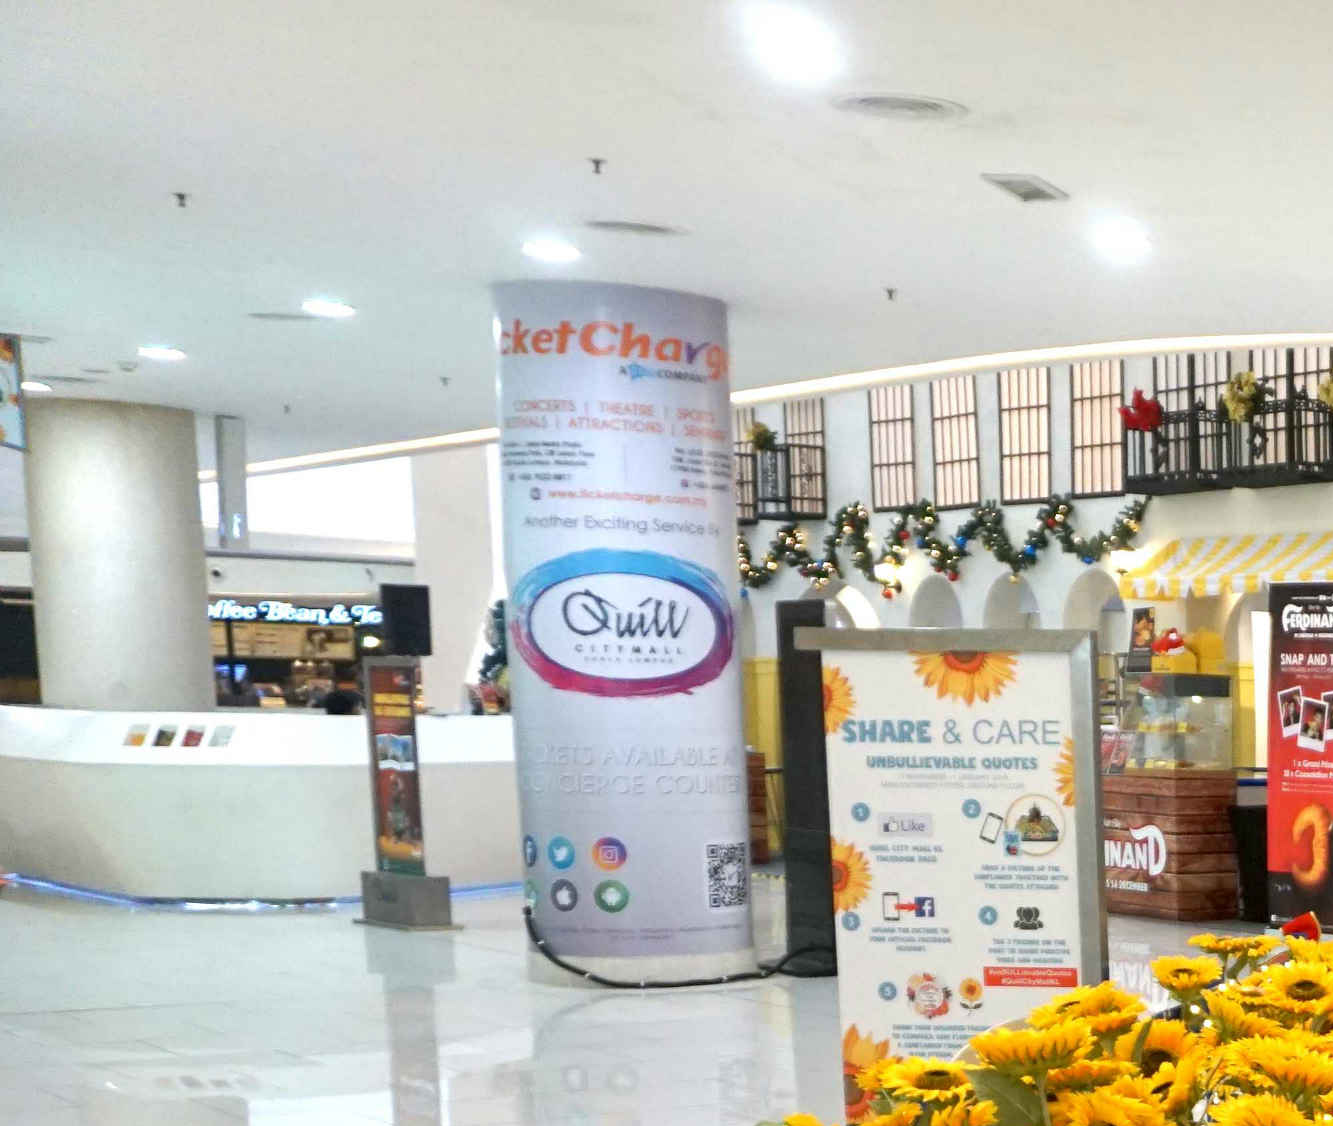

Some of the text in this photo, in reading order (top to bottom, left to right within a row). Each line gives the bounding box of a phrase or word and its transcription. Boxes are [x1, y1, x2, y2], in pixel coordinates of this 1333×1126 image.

[600, 402, 655, 417] THEATRE
[568, 418, 664, 434] ATTRACTIONS
[523, 515, 579, 530] Another
[584, 515, 648, 535] Exciting
[653, 518, 705, 536] Service
[259, 601, 329, 625] Bean
[352, 605, 383, 624] Te
[563, 589, 690, 639] Quill
[1280, 653, 1304, 665] SNAP
[1307, 654, 1327, 666] AND
[842, 719, 1061, 745] SHARE & CARE
[866, 755, 1038, 770] UNBULLIEVABLE QUOTES
[656, 774, 740, 795] COUNTE
[901, 821, 926, 833] Like
[1104, 824, 1167, 876] INAND
